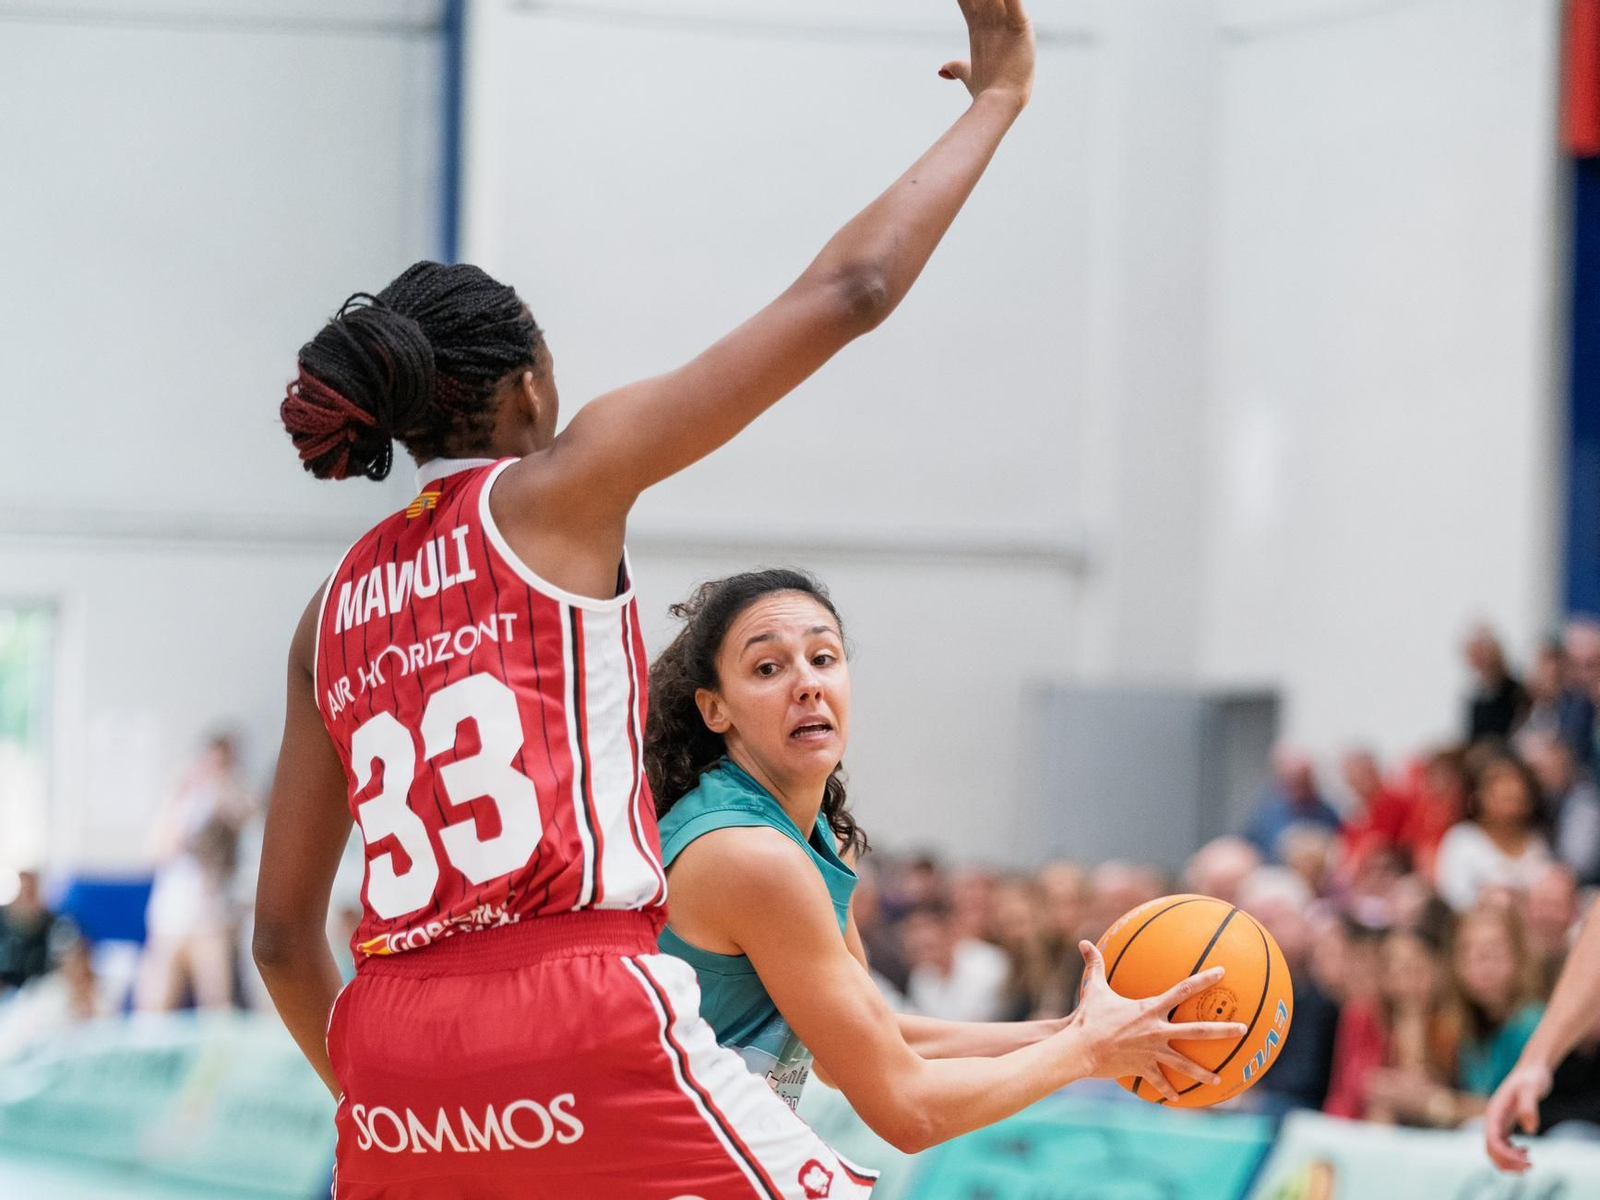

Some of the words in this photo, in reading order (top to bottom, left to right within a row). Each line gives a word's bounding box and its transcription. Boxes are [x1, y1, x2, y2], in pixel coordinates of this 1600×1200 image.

[327, 675, 356, 721] AIR
[356, 612, 518, 695] HORIZONT
[350, 670, 544, 920] 33
[351, 1092, 585, 1154] SOMMOS
